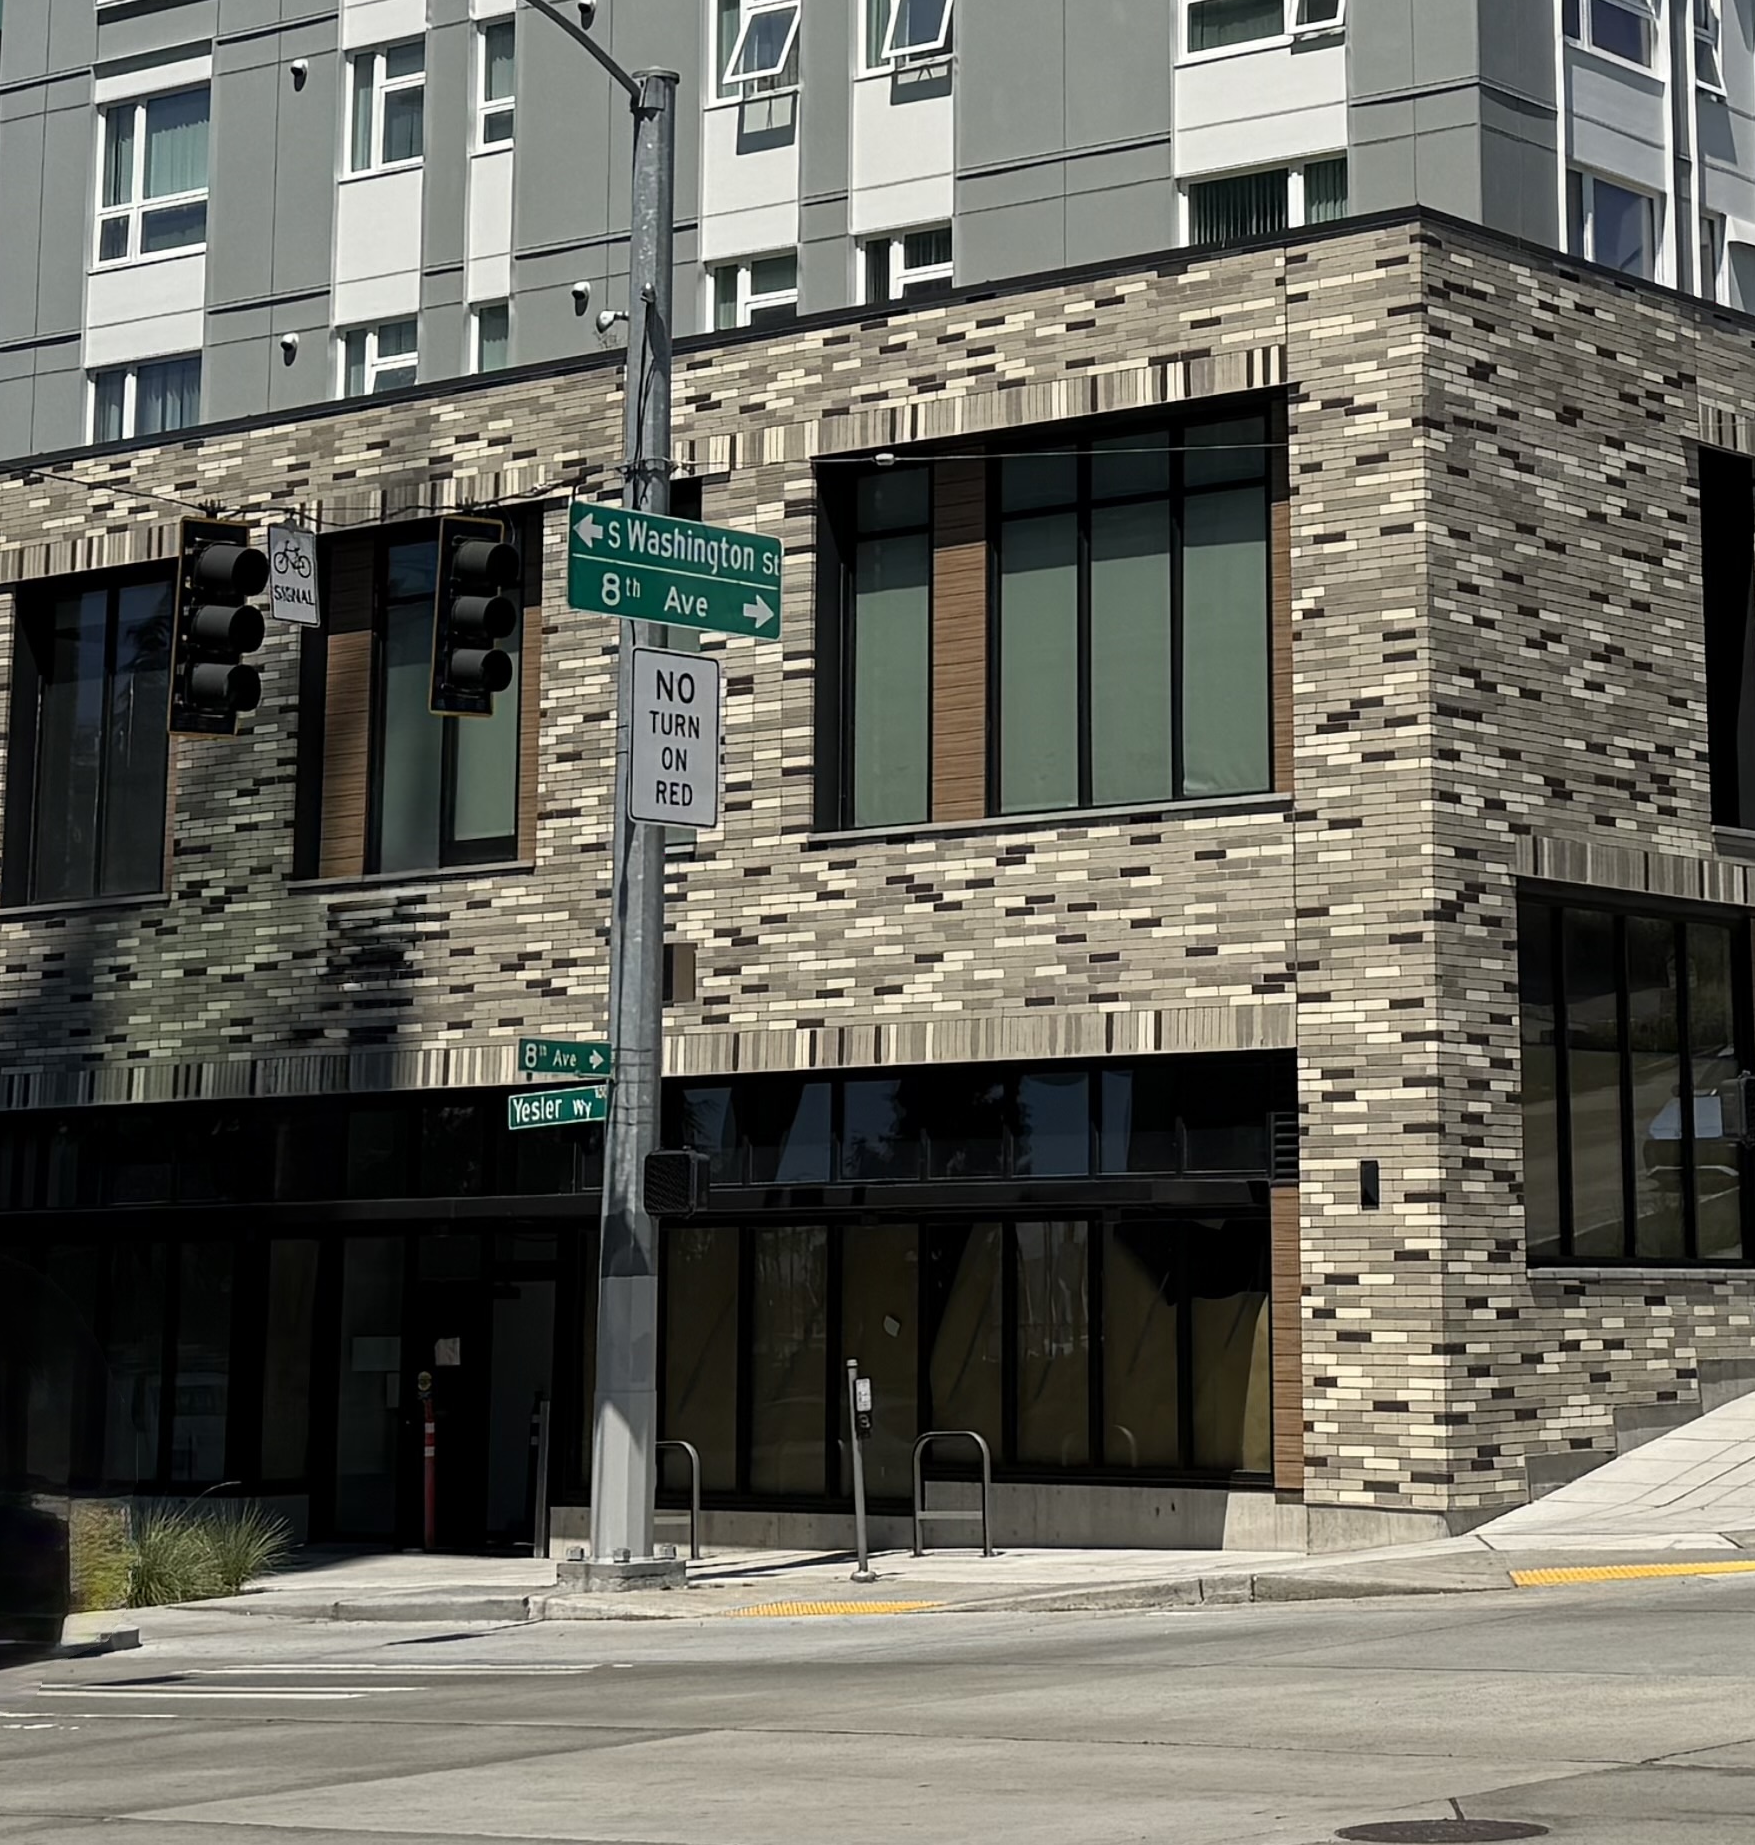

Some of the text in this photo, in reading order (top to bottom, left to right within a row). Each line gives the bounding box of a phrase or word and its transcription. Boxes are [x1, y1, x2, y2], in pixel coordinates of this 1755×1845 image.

[607, 517, 780, 577] S Washington St
[274, 584, 316, 606] SIGNAL
[601, 572, 708, 617] 8th Ave
[656, 669, 695, 704] NO
[649, 710, 700, 740] TURN
[661, 746, 687, 772] ON
[656, 780, 693, 807] RED
[524, 1042, 577, 1068] 8th Ave
[512, 1098, 592, 1124] Yesler Wy
